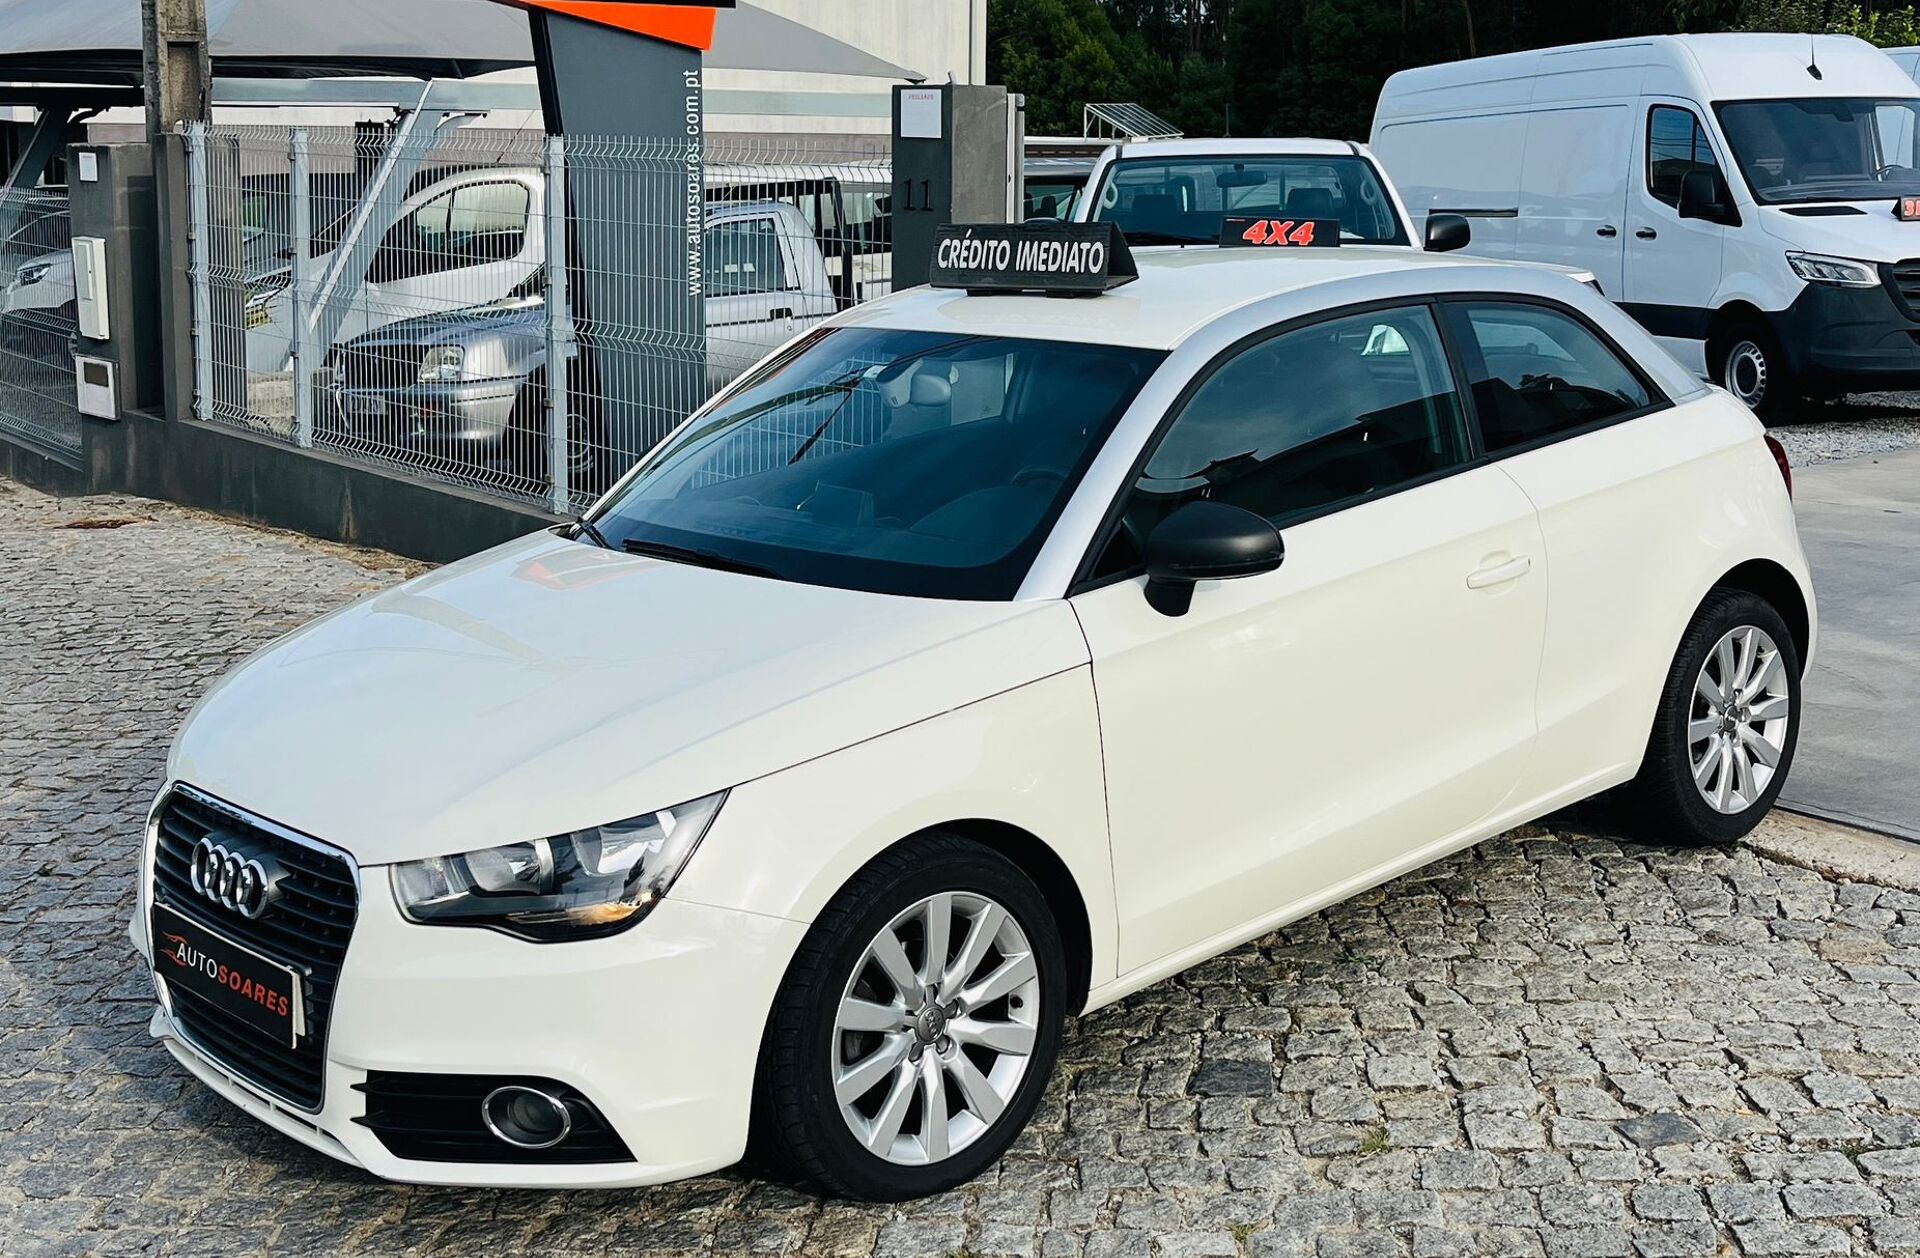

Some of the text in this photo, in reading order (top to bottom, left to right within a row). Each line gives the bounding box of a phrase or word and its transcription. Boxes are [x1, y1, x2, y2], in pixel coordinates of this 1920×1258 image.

[683, 69, 701, 297] www.autosoares.com.pt
[903, 178, 934, 211] 11
[937, 228, 1104, 274] CRÉDITO IMEDIATO
[1242, 219, 1315, 246] 4X4
[176, 942, 288, 1016] AUTOSOARES
